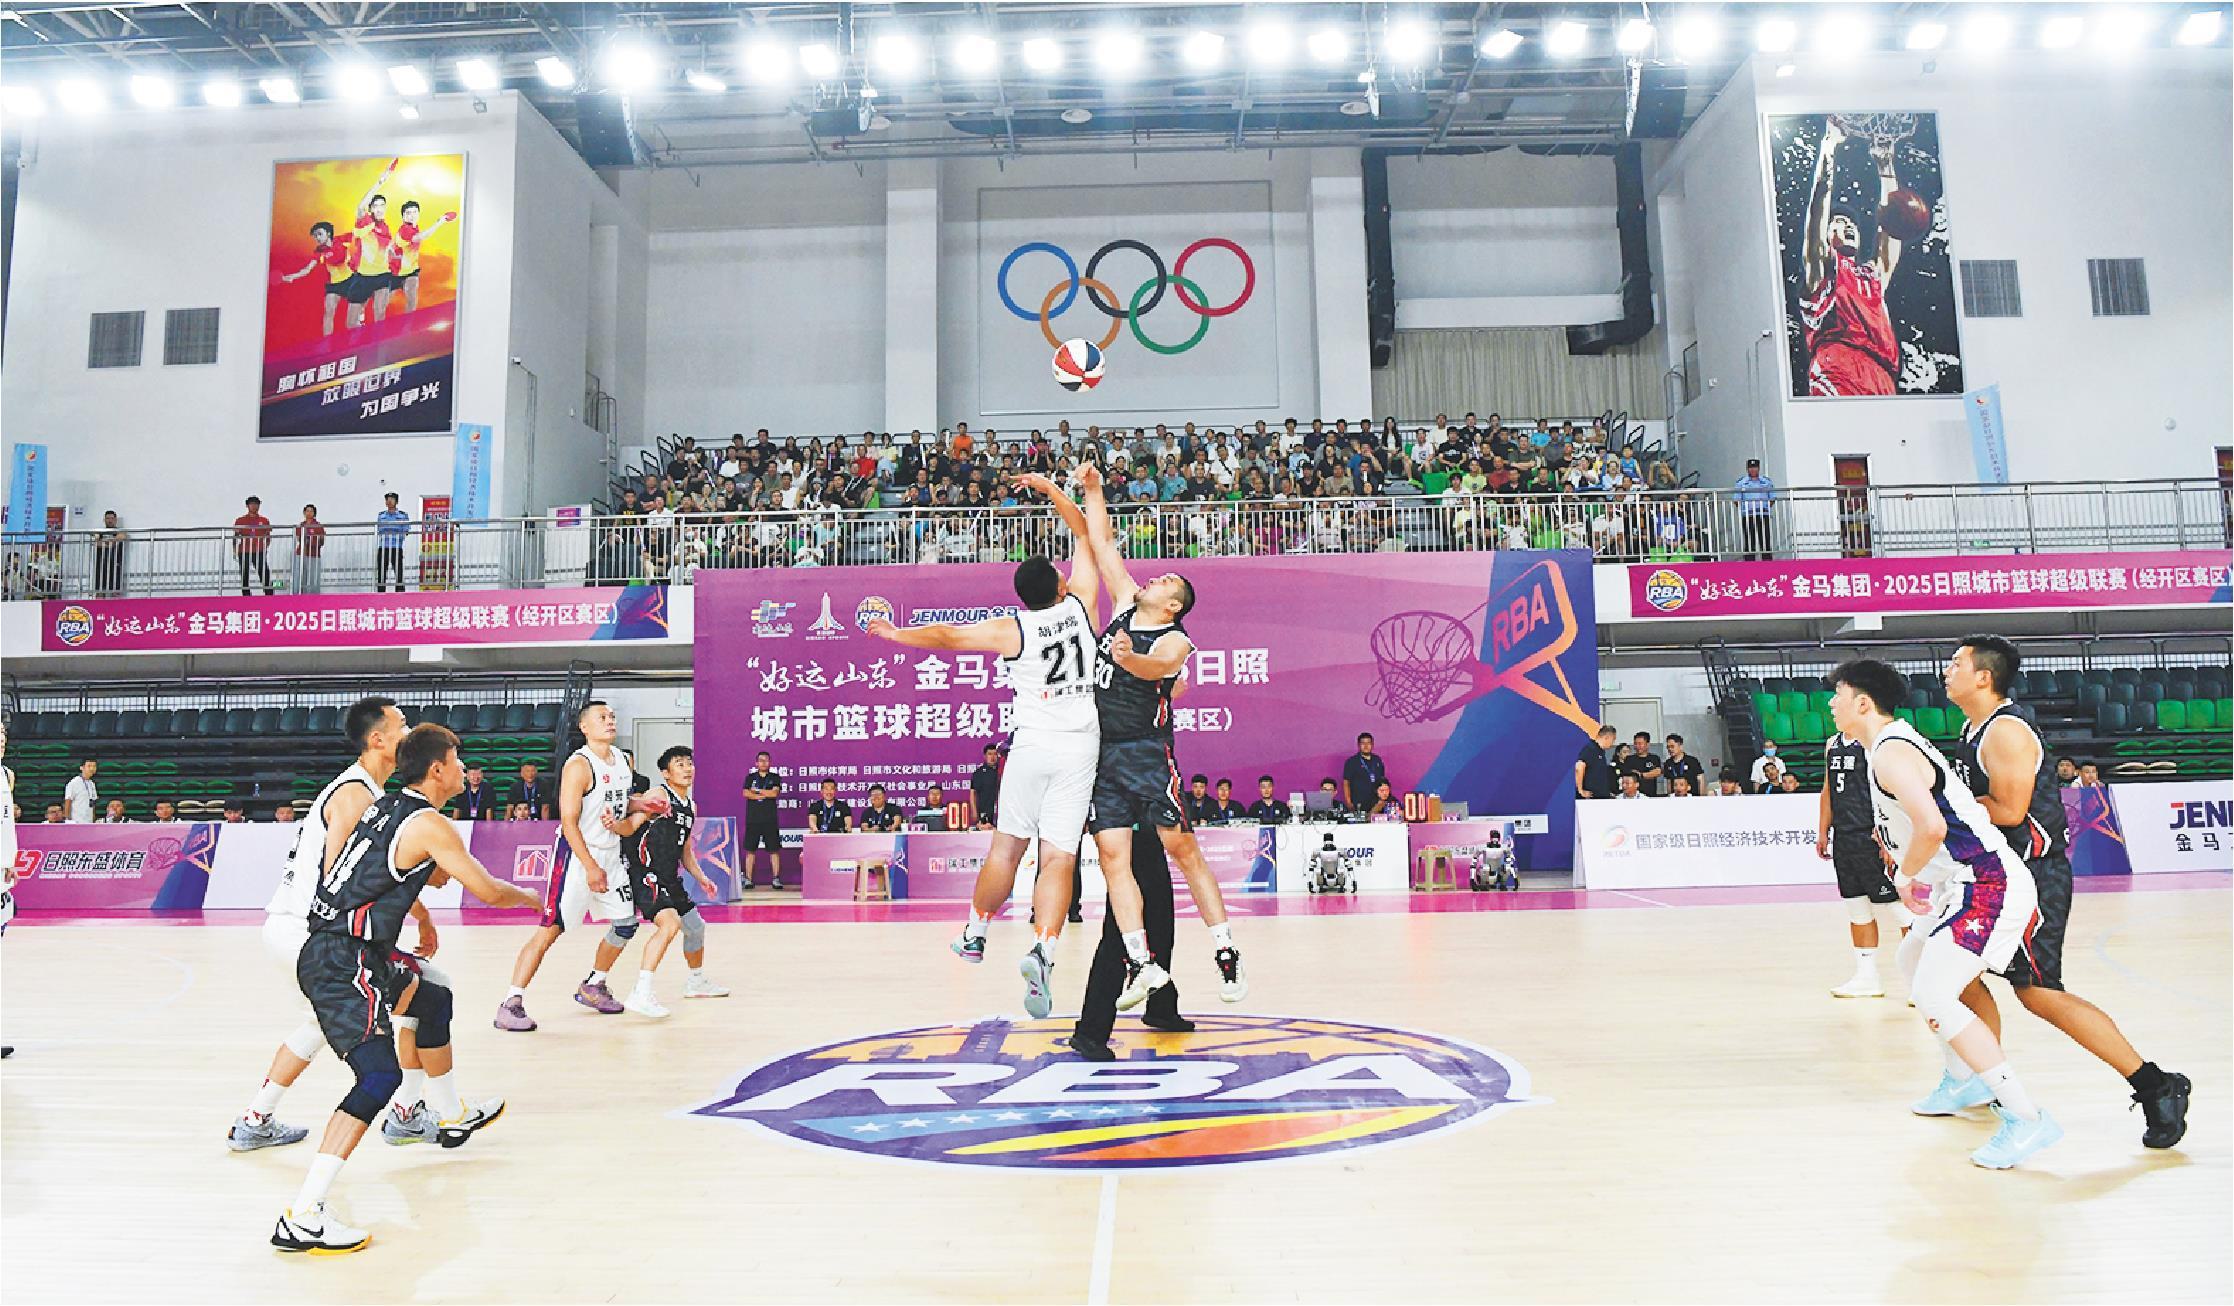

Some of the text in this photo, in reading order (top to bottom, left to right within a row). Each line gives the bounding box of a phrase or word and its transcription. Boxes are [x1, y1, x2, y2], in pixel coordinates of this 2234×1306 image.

[360, 381, 440, 419] 为国争光
[1650, 587, 1684, 599] RBA
[60, 621, 91, 634] RBA
[909, 607, 989, 625] JENMOUR
[1492, 583, 1550, 665] RBA
[1041, 633, 1085, 686] 21
[1836, 772, 1846, 793] 5
[2170, 800, 2233, 829] JEN
[2175, 832, 2233, 851] 金马
[717, 1055, 1482, 1114] RBA
